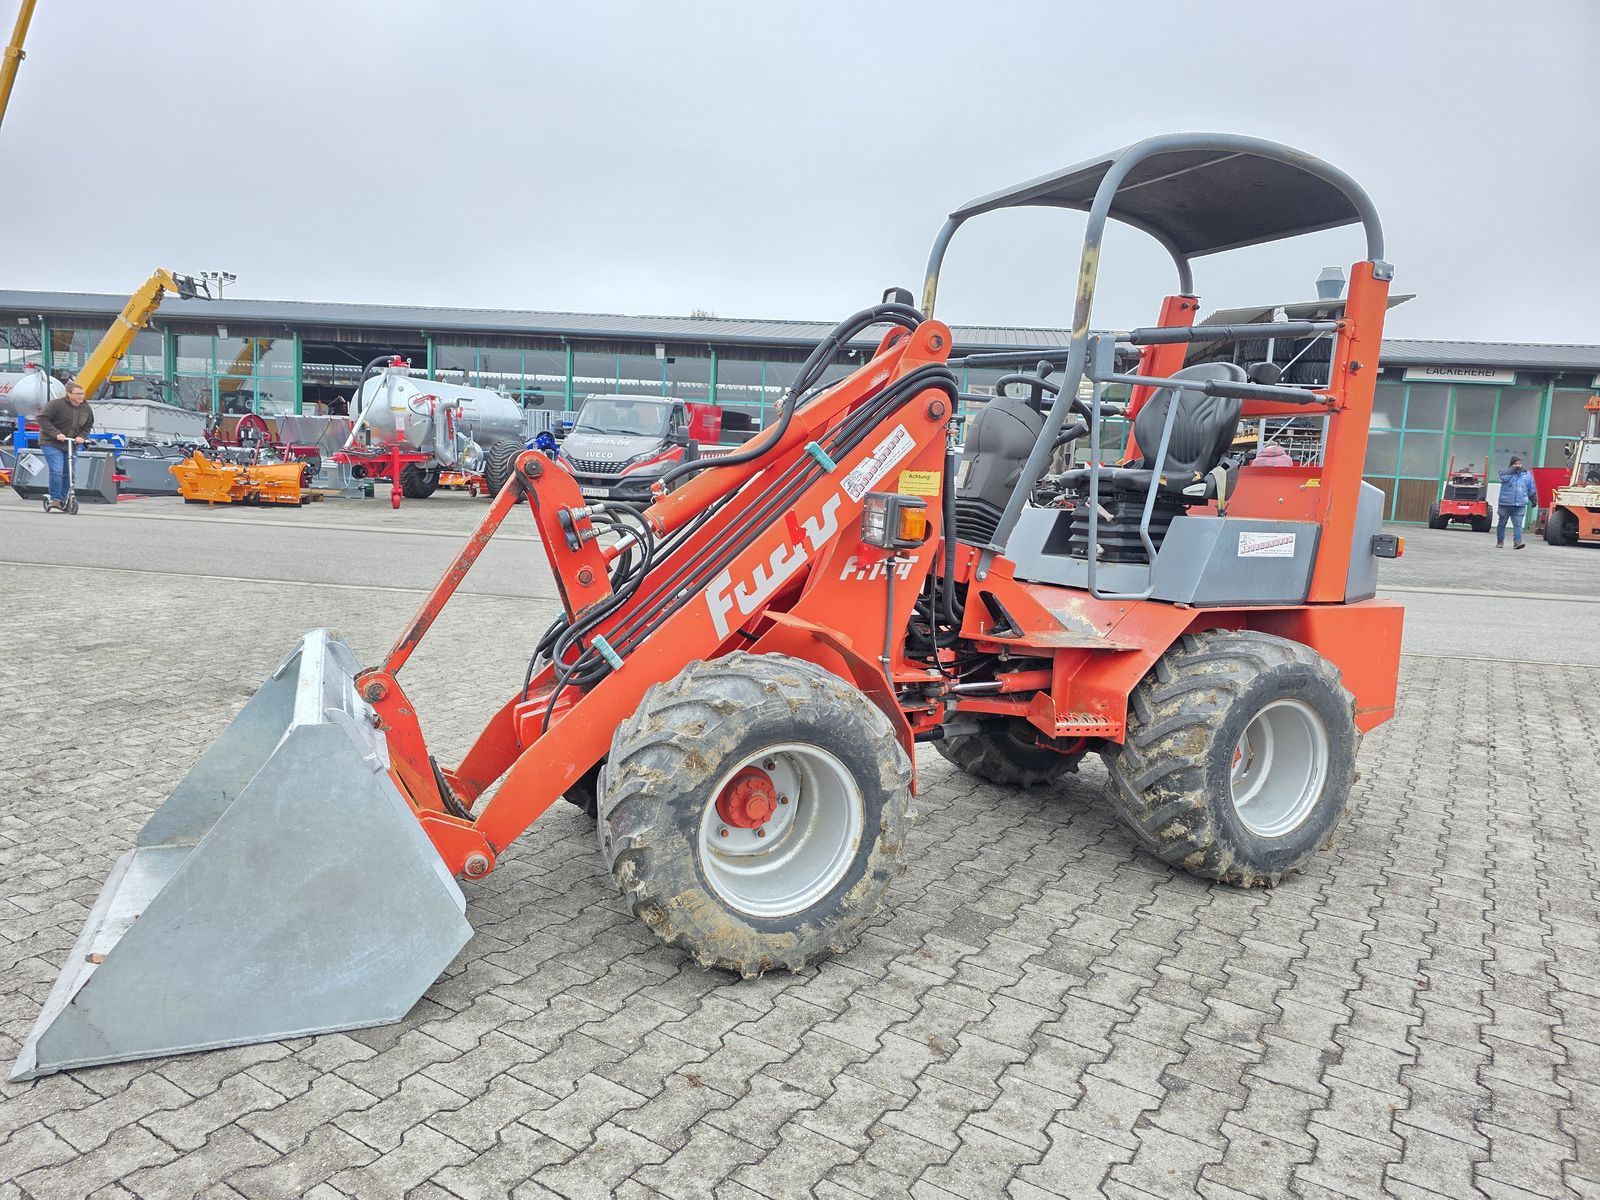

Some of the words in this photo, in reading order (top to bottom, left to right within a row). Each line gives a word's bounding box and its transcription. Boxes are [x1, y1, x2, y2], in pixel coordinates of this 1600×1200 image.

[1426, 367, 1496, 378] LACKIEREREI
[585, 451, 613, 459] IVECO
[908, 473, 932, 481] Achtung!
